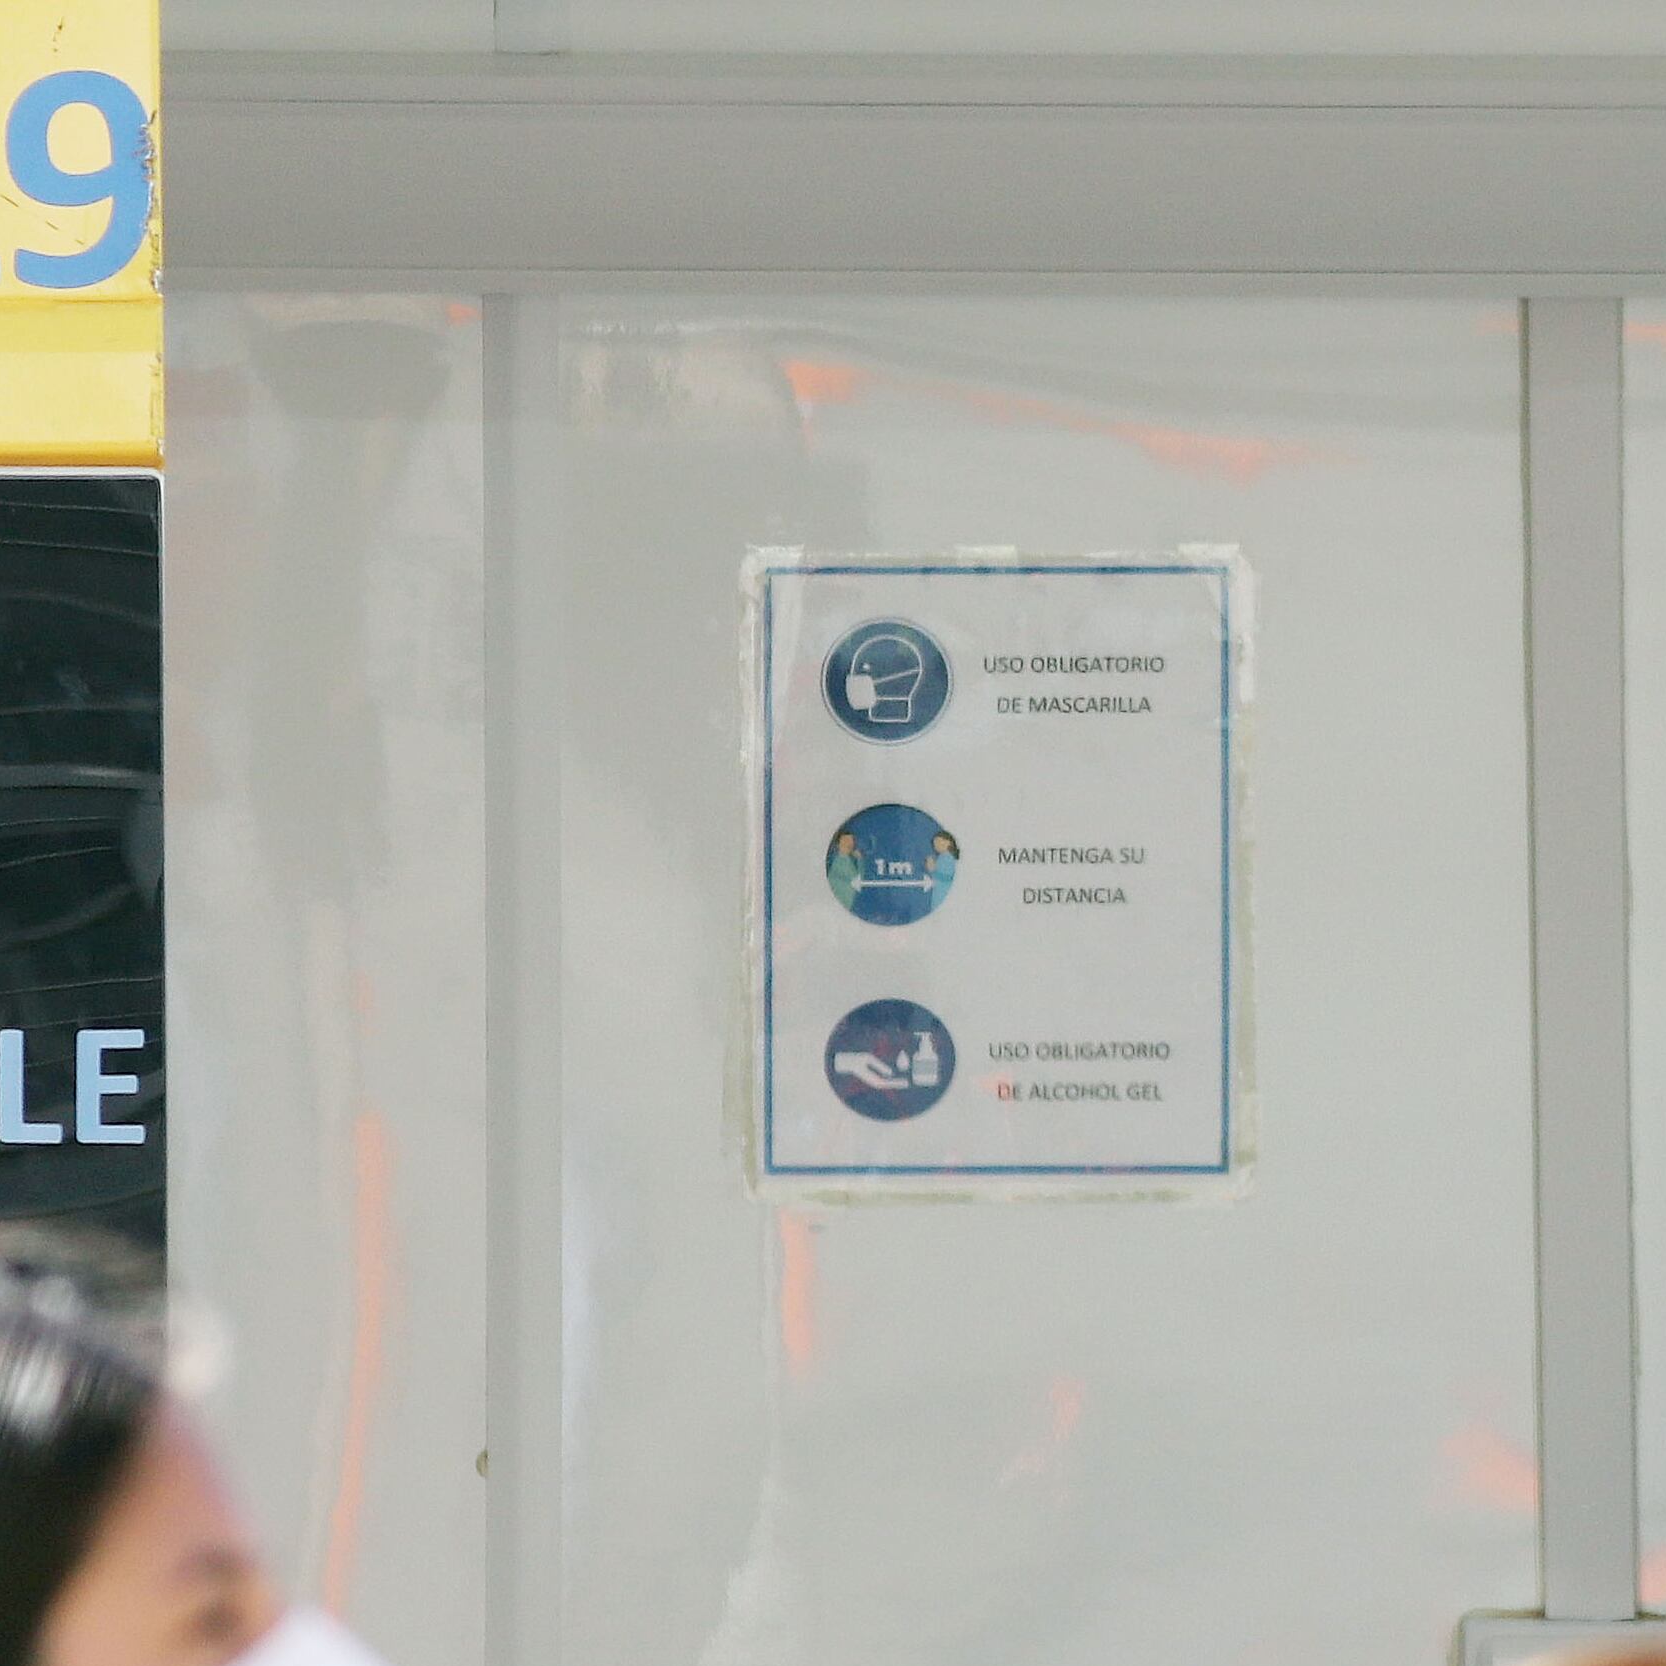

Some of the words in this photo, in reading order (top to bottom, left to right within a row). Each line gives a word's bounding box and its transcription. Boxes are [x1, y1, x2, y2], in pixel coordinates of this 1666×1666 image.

[983, 656, 1023, 674] USO
[1030, 656, 1165, 674] OBLIGATORIO
[997, 697, 1022, 714] DE
[1029, 697, 1152, 715] MASCARILLA
[998, 847, 1113, 865] MANTENGA
[1119, 847, 1145, 865] SU
[1023, 888, 1126, 905] DISTANCIA
[988, 1042, 1029, 1060] USO
[1036, 1042, 1171, 1061] OBLIGATORIO
[997, 1083, 1023, 1100] DE
[1029, 1083, 1120, 1100] ALCOHOL
[1126, 1083, 1163, 1101] GEL
